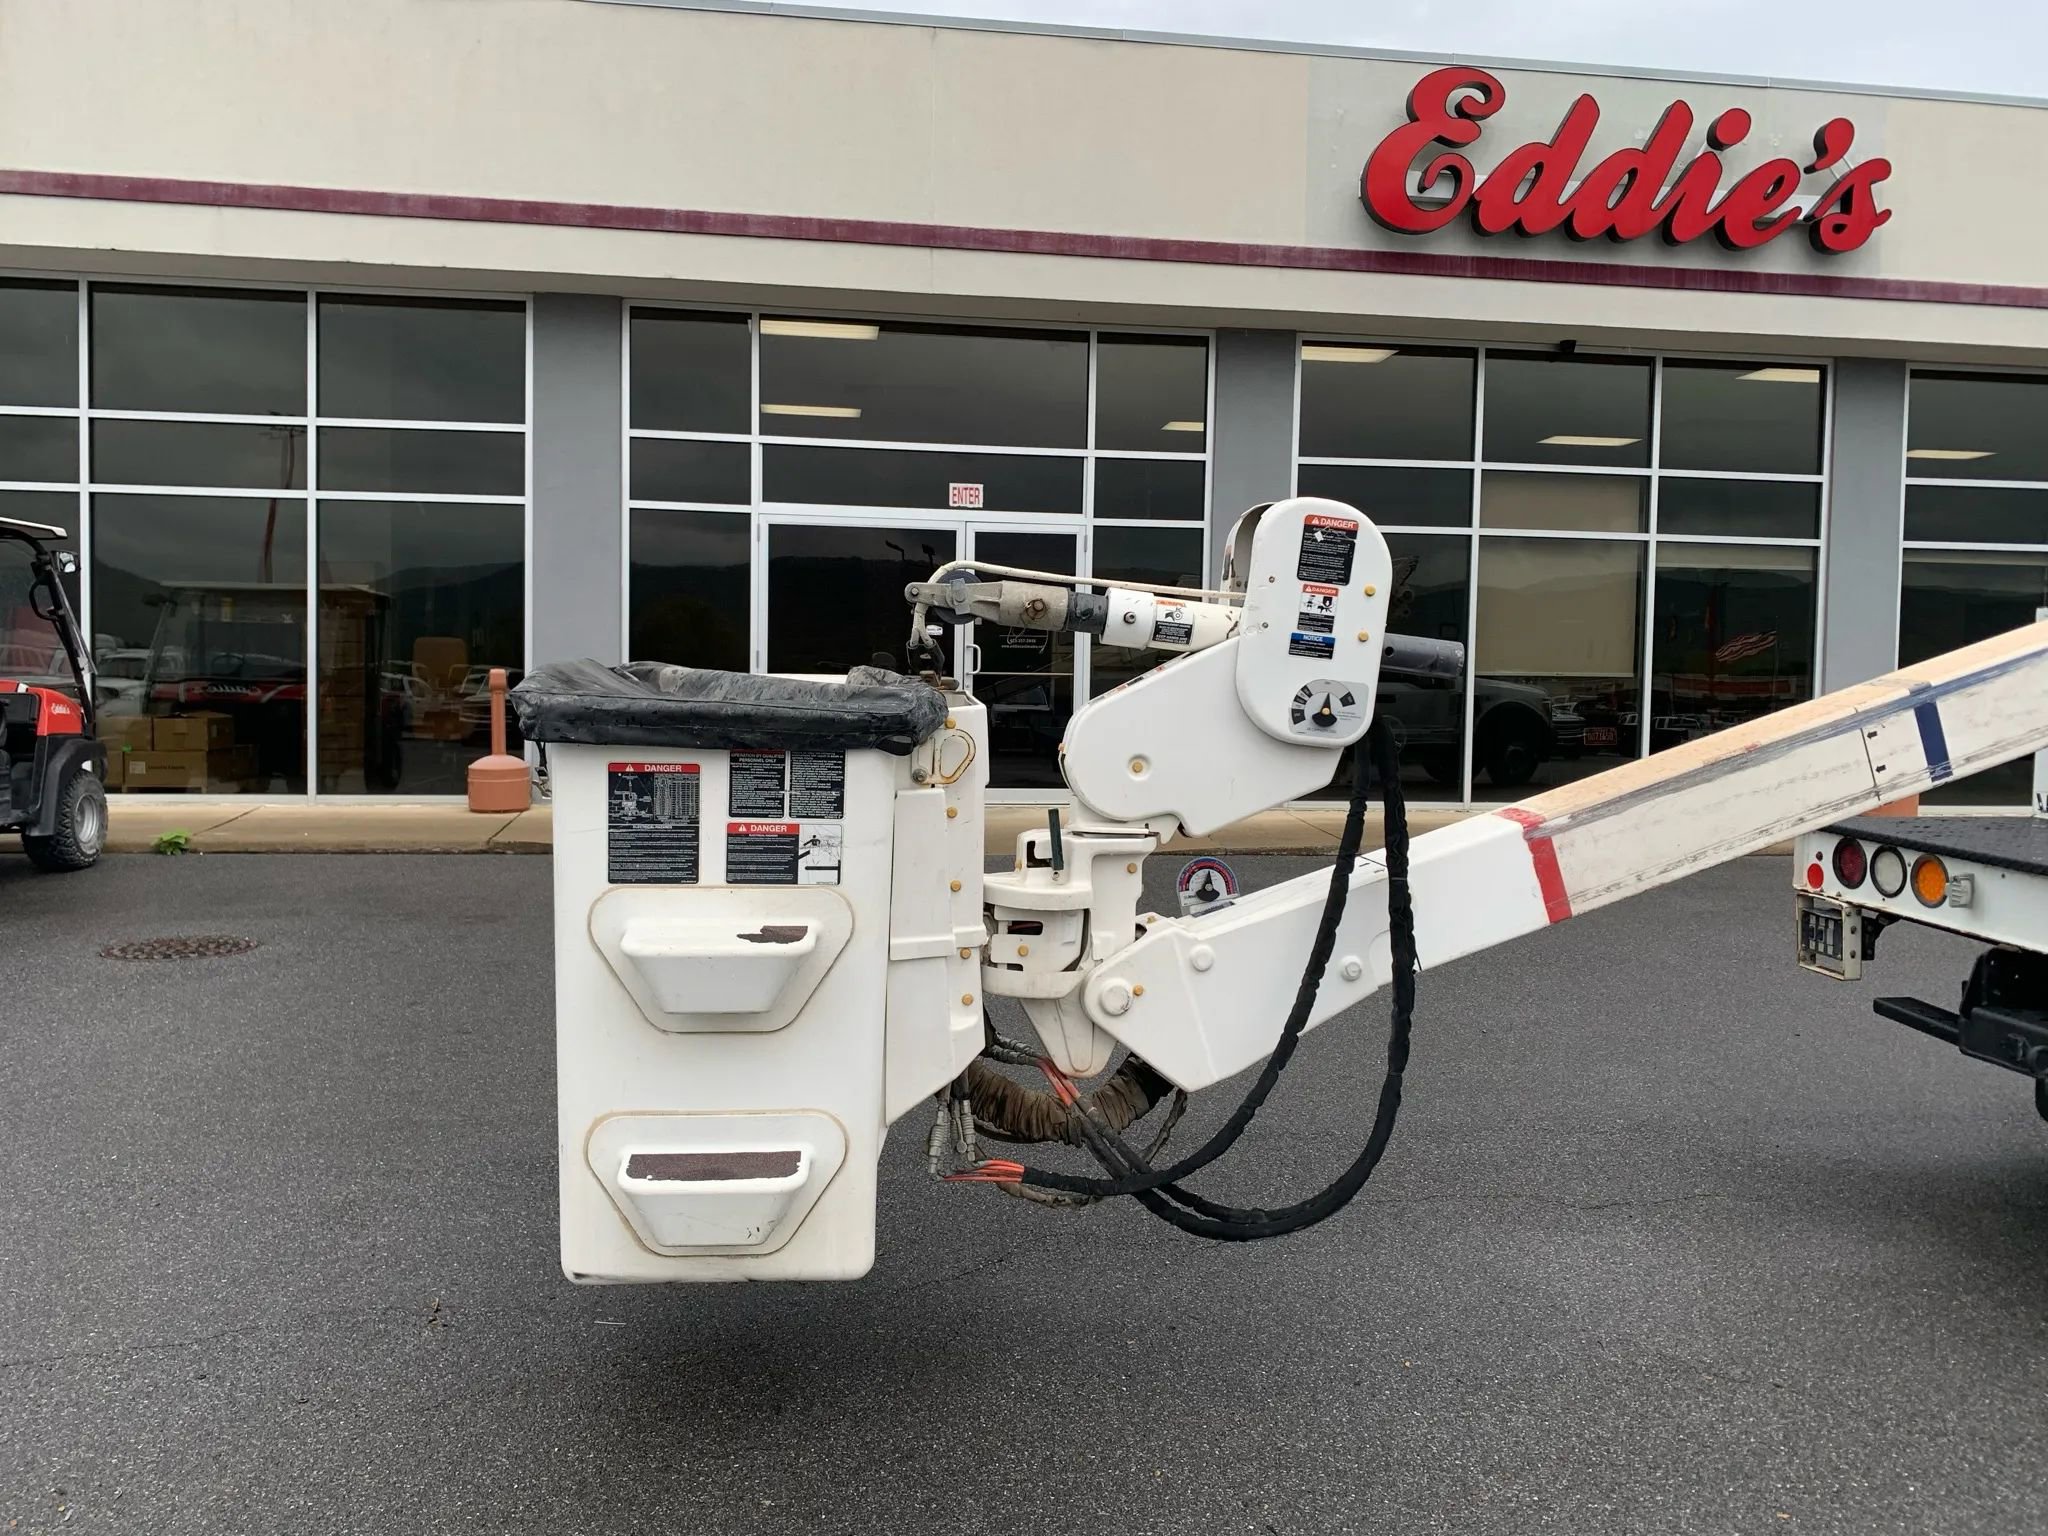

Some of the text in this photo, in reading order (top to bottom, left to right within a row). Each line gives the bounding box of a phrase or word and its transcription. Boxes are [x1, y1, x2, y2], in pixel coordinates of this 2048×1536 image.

[1360, 66, 1893, 255] Eddie's
[952, 486, 980, 505] ENTER
[1320, 517, 1354, 529] DANGER
[1311, 586, 1336, 595] DANGER
[1302, 634, 1323, 642] NOTICE
[644, 763, 682, 773] DANGER
[750, 823, 787, 833] DANGER
